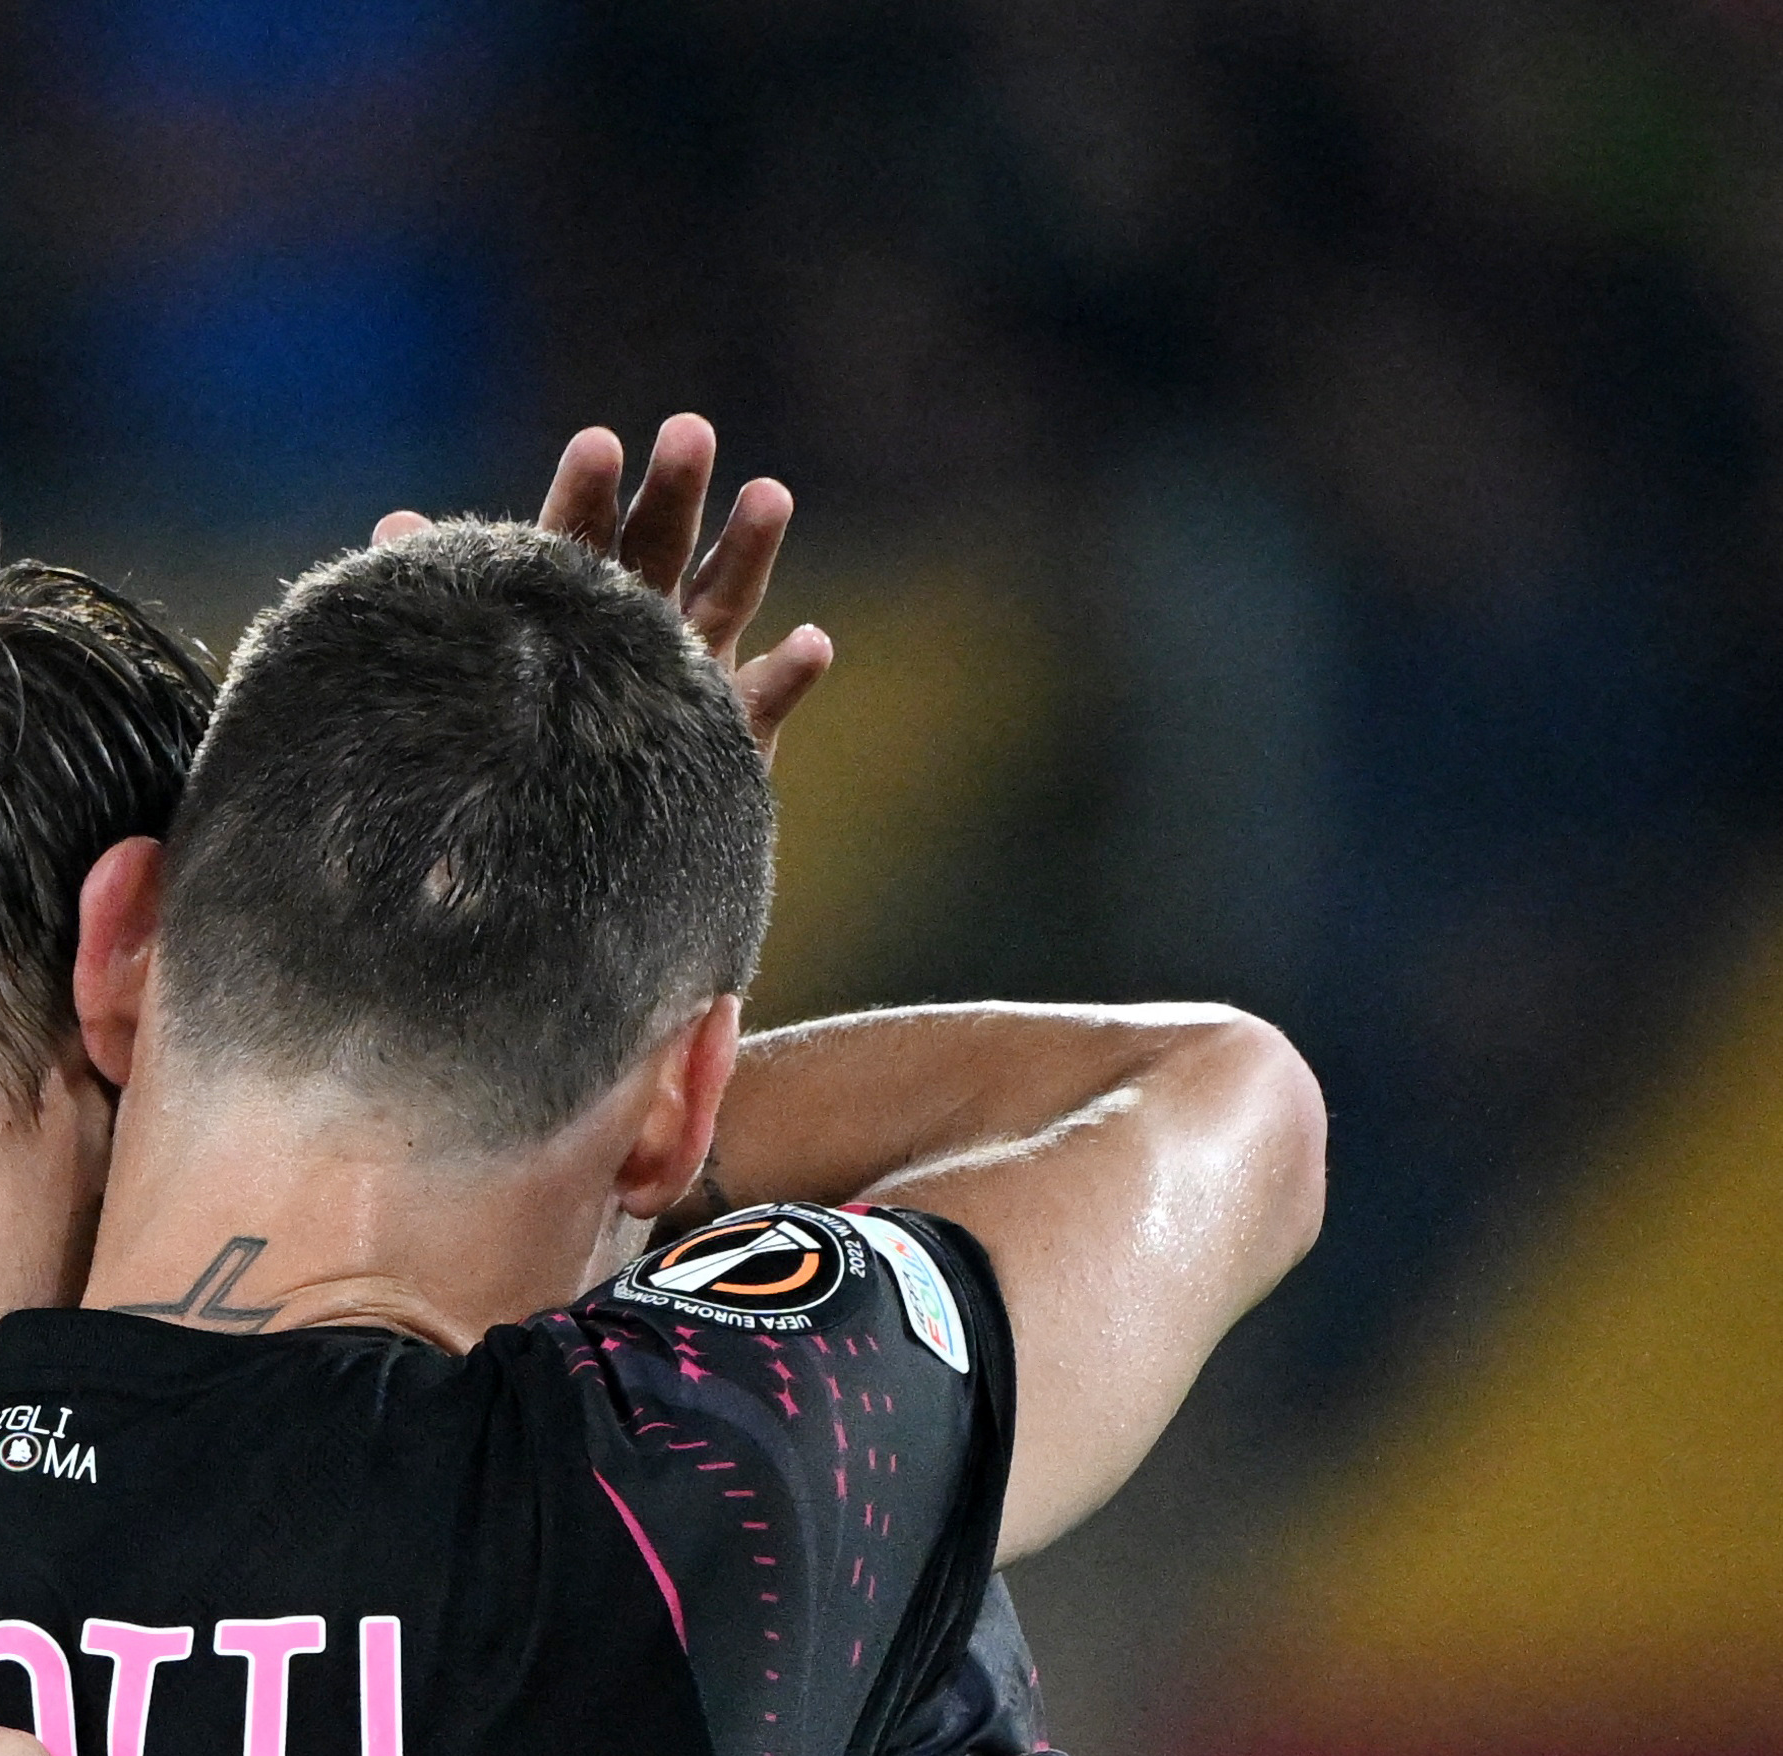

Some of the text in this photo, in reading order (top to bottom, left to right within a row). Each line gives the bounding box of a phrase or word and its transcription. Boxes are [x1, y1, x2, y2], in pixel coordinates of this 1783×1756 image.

[844, 1240, 866, 1278] 2022
[673, 1300, 757, 1330] EUROPA
[759, 1314, 813, 1331] UEFA
